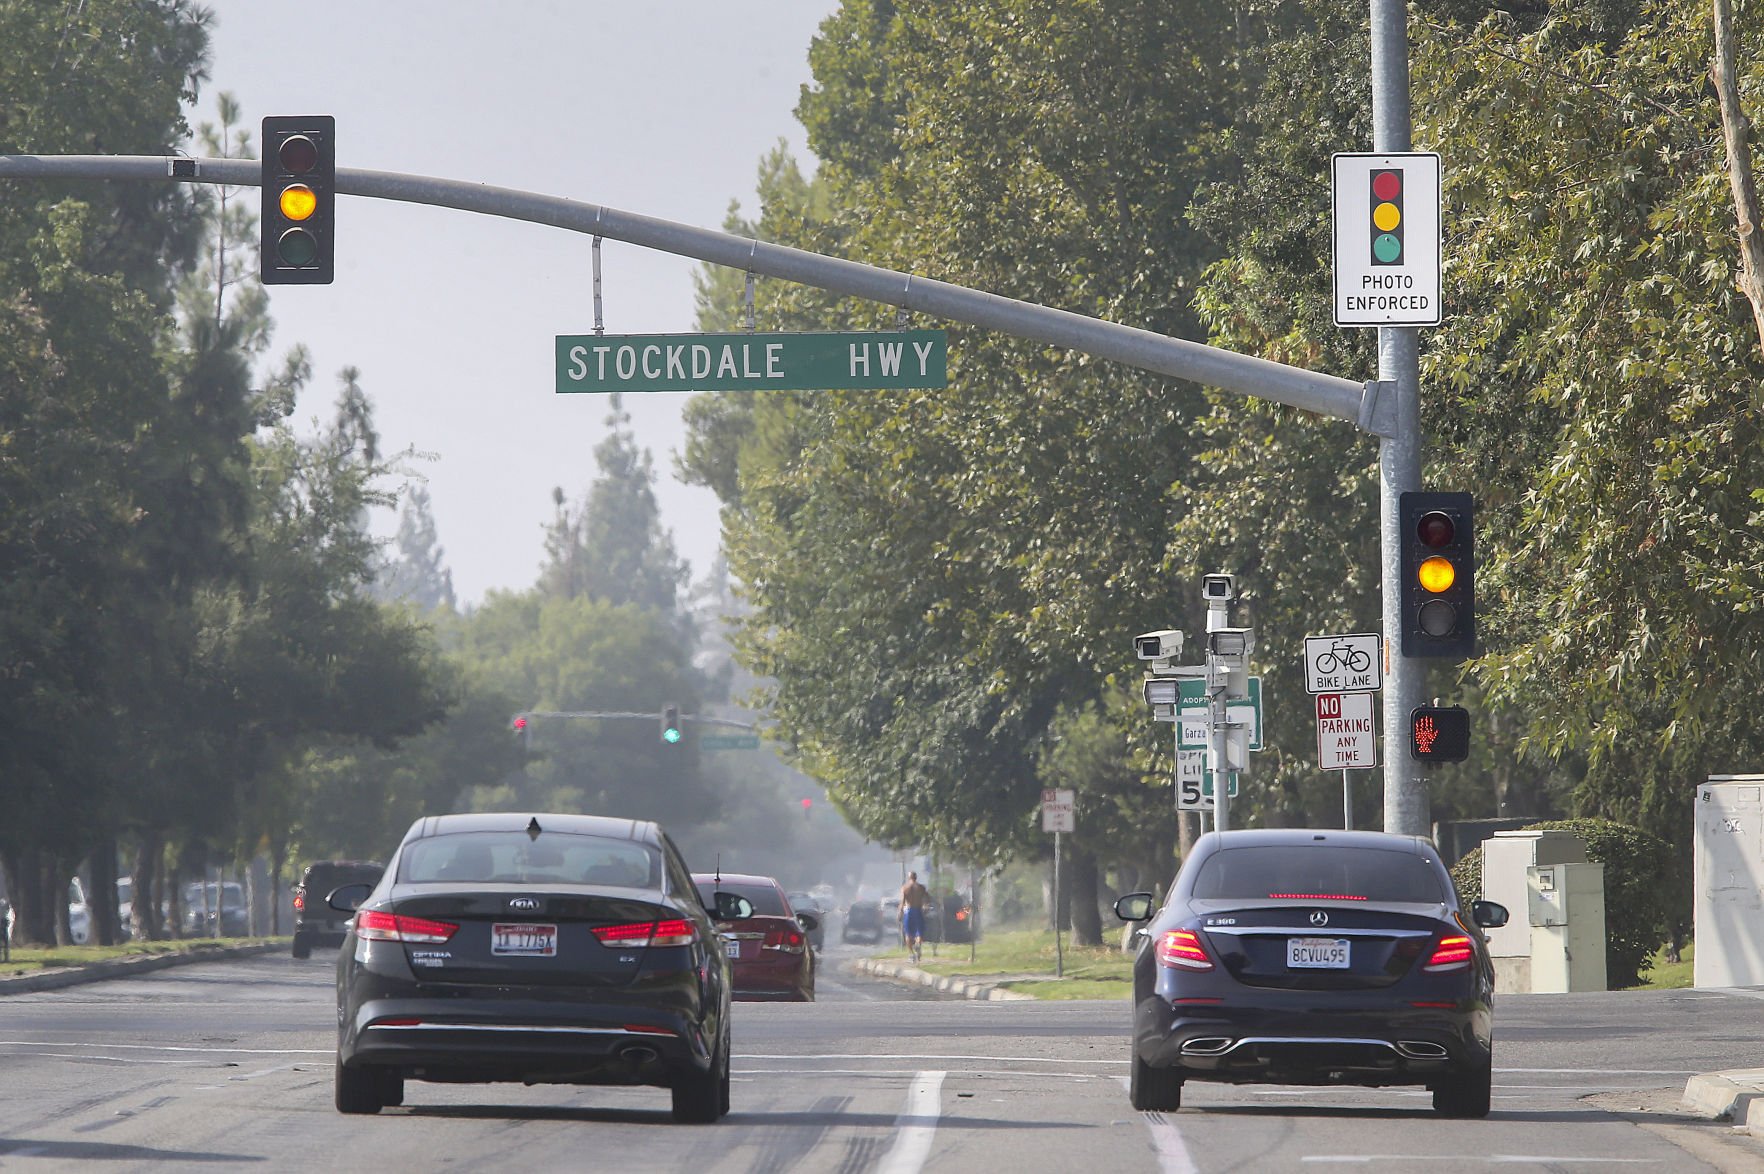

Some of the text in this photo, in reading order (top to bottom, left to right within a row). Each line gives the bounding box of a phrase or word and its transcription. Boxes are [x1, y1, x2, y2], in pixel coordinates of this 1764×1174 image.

[1362, 275, 1413, 289] PHOTO
[1346, 296, 1429, 310] ENFORCED
[567, 341, 934, 381] STOCKDALE HWY
[1317, 675, 1371, 688] BIKE LANE
[1320, 698, 1339, 715] NO
[1321, 719, 1370, 733] PARKING
[1337, 737, 1357, 748] ANY
[1336, 751, 1359, 762] TIME
[1292, 948, 1346, 963] 8CVU495
